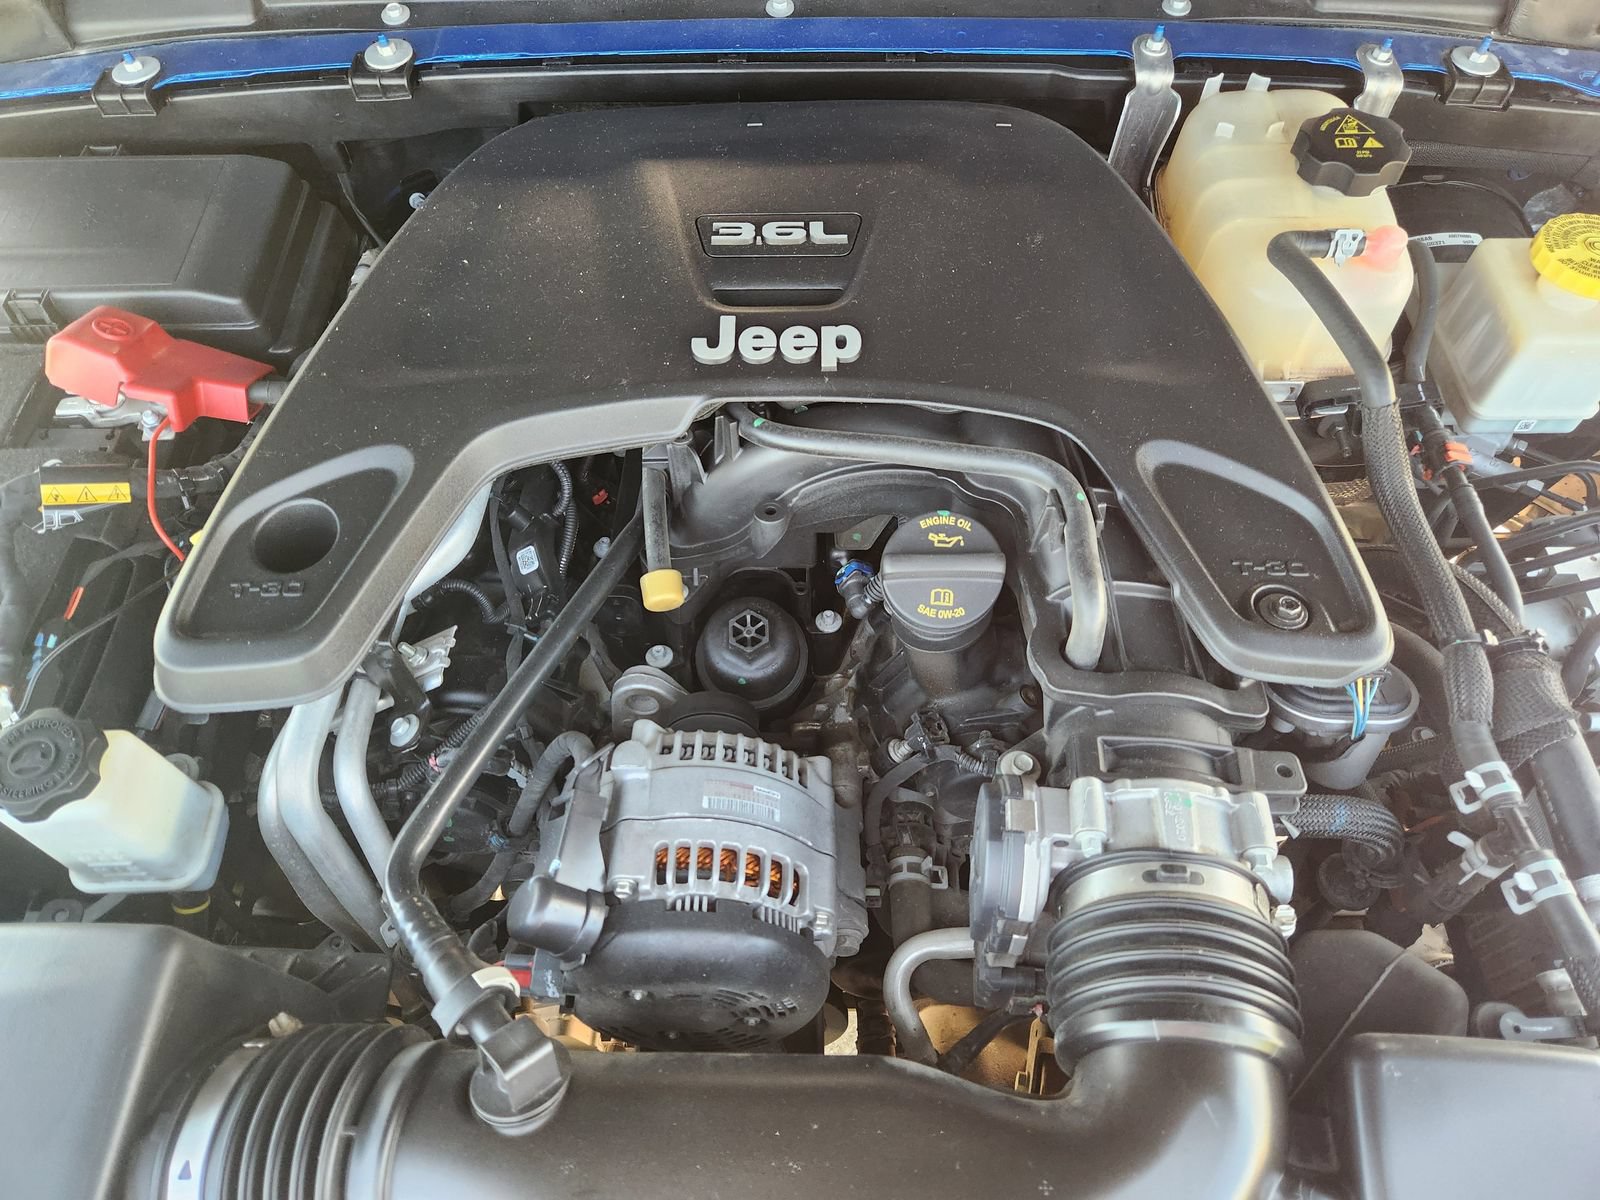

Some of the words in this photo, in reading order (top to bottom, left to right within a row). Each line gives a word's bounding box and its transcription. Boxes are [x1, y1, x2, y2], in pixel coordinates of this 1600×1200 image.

[711, 221, 849, 246] 3.6L
[691, 315, 862, 372] Jeep
[919, 516, 956, 529] ENGINE
[957, 519, 972, 532] OIL
[917, 604, 937, 618] SAE
[938, 606, 966, 620] 0W-20
